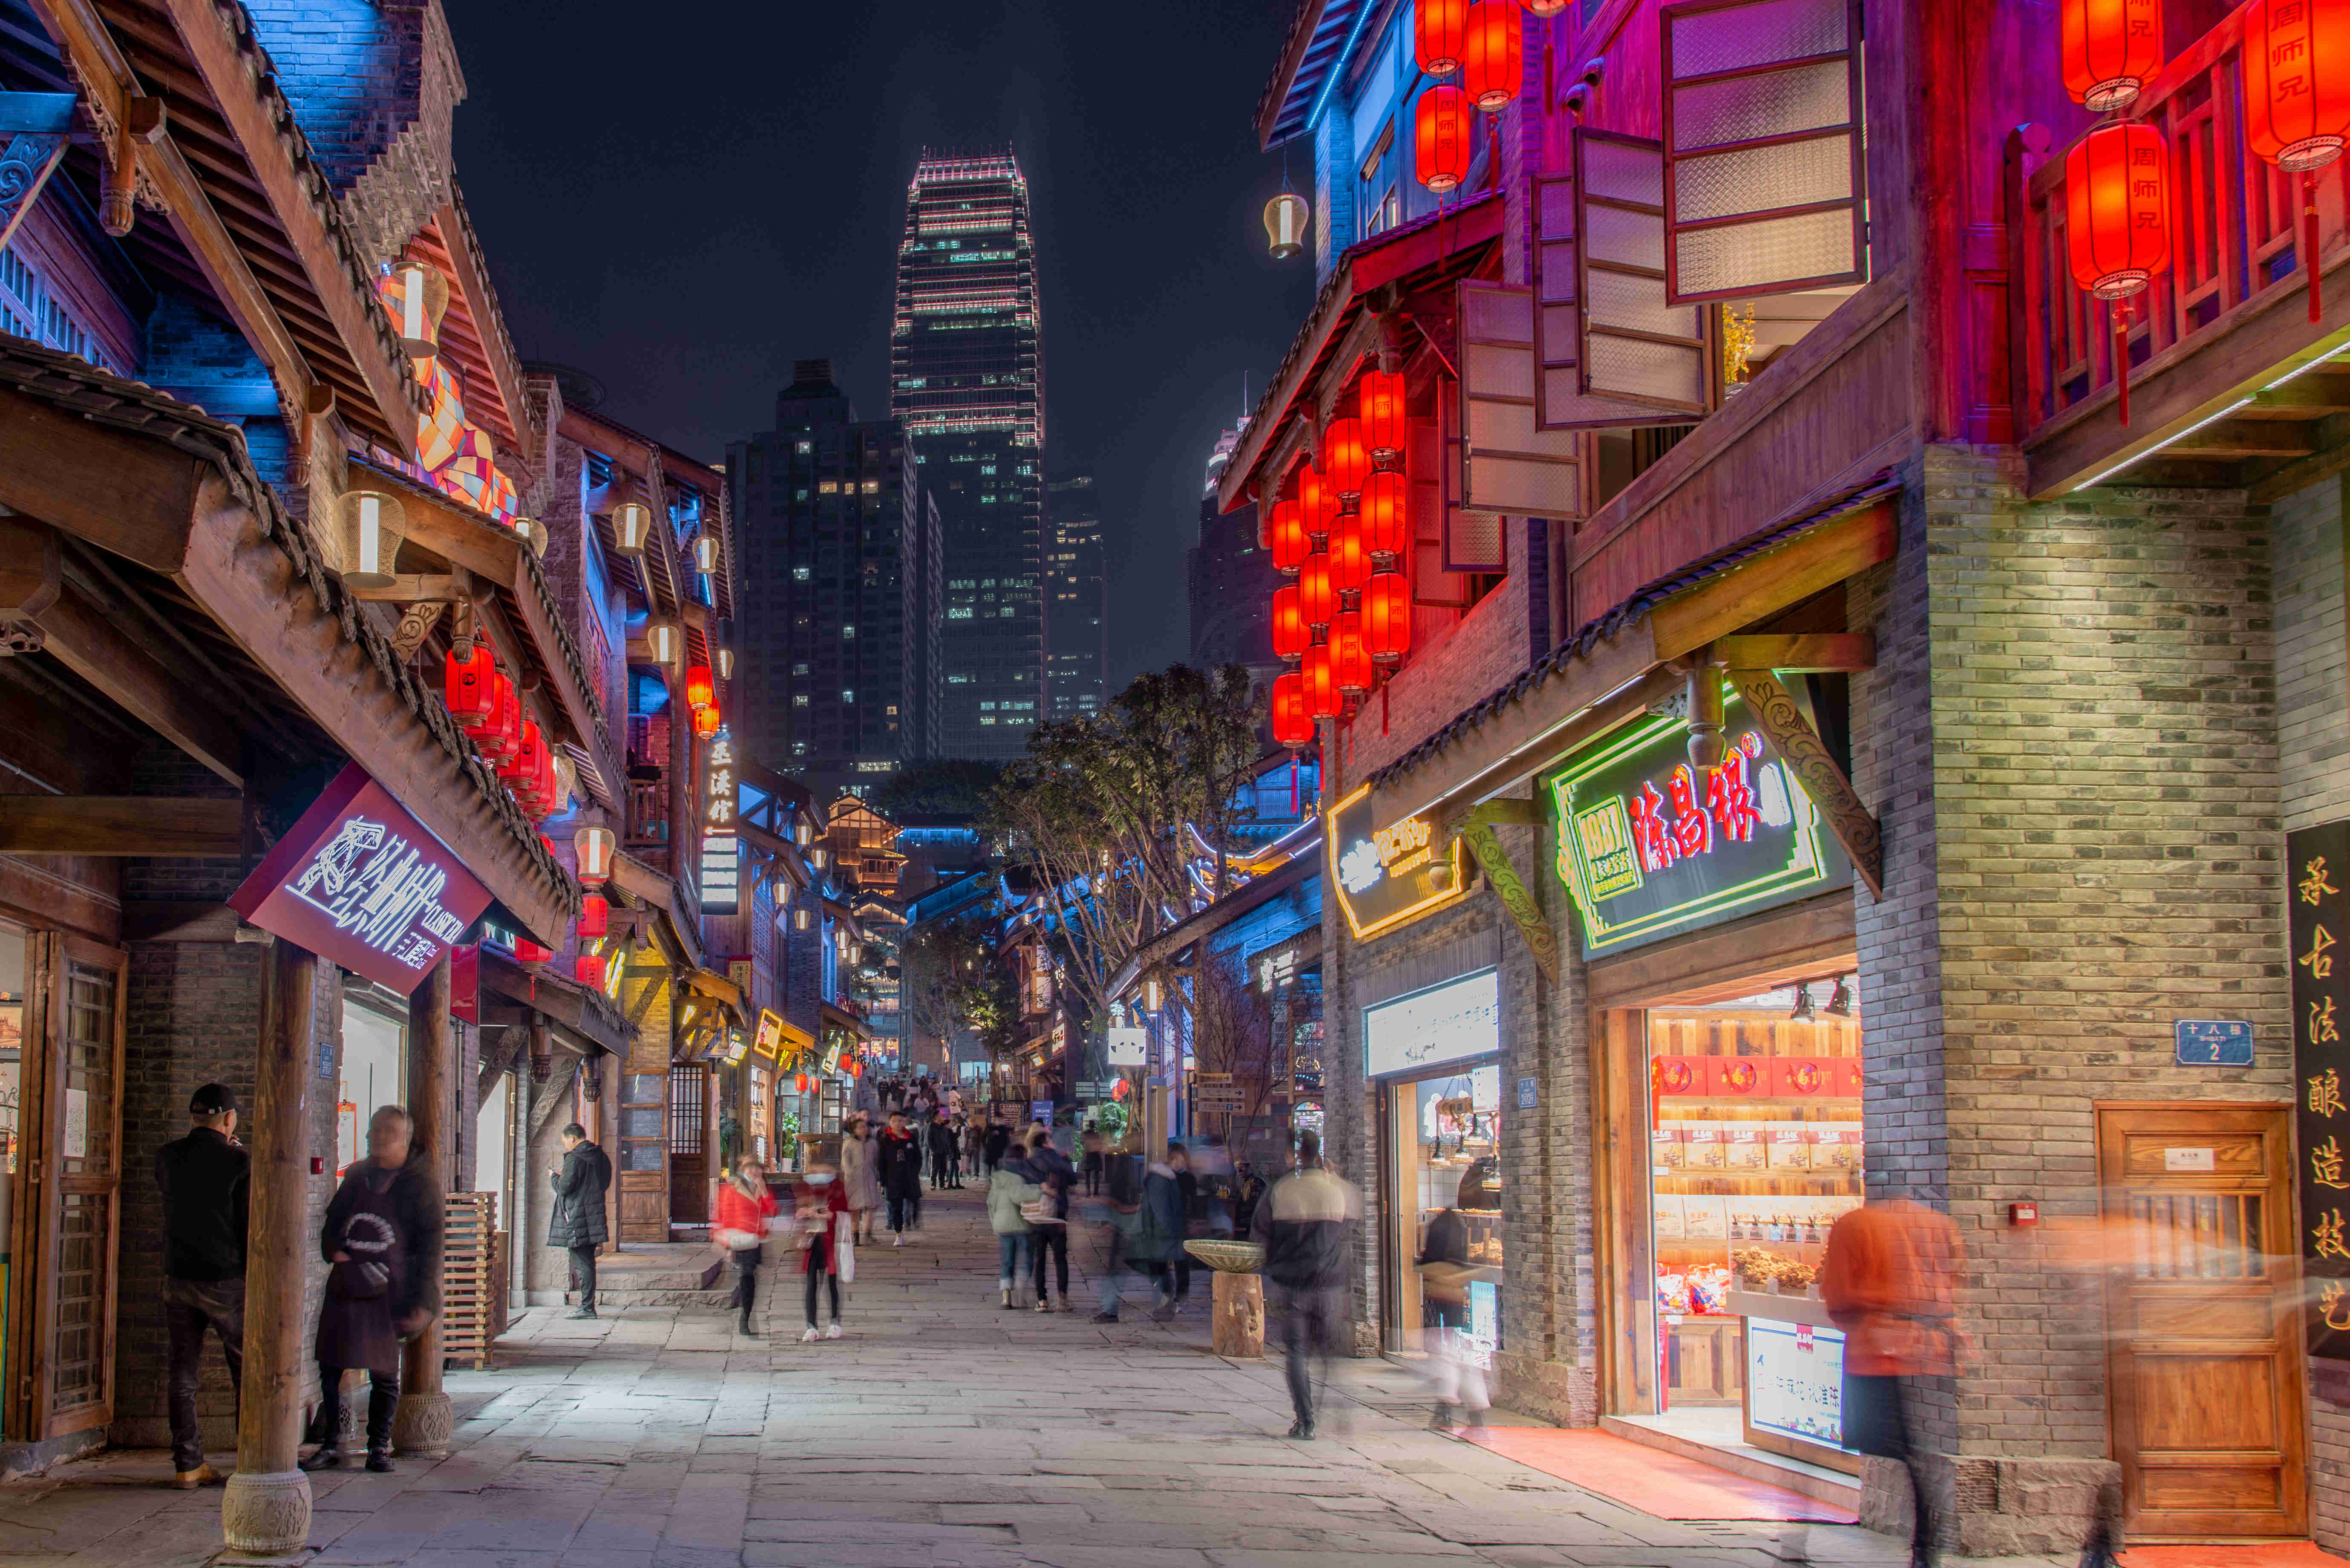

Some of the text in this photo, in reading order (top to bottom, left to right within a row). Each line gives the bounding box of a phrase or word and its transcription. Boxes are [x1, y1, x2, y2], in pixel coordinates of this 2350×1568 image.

[2269, 1, 2310, 102] 周师兄
[1438, 100, 1455, 150] 周师兄
[2131, 147, 2160, 229] 周师兄
[1376, 383, 1391, 428] 周师兄
[1343, 624, 1357, 667] 周师兄
[1579, 804, 1623, 860] 1937
[421, 904, 457, 938] CLASSIC
[2187, 1023, 2243, 1036] 十八梯
[2210, 1043, 2220, 1061] 2
[2298, 855, 2350, 1331] 承古法酿造技艺
